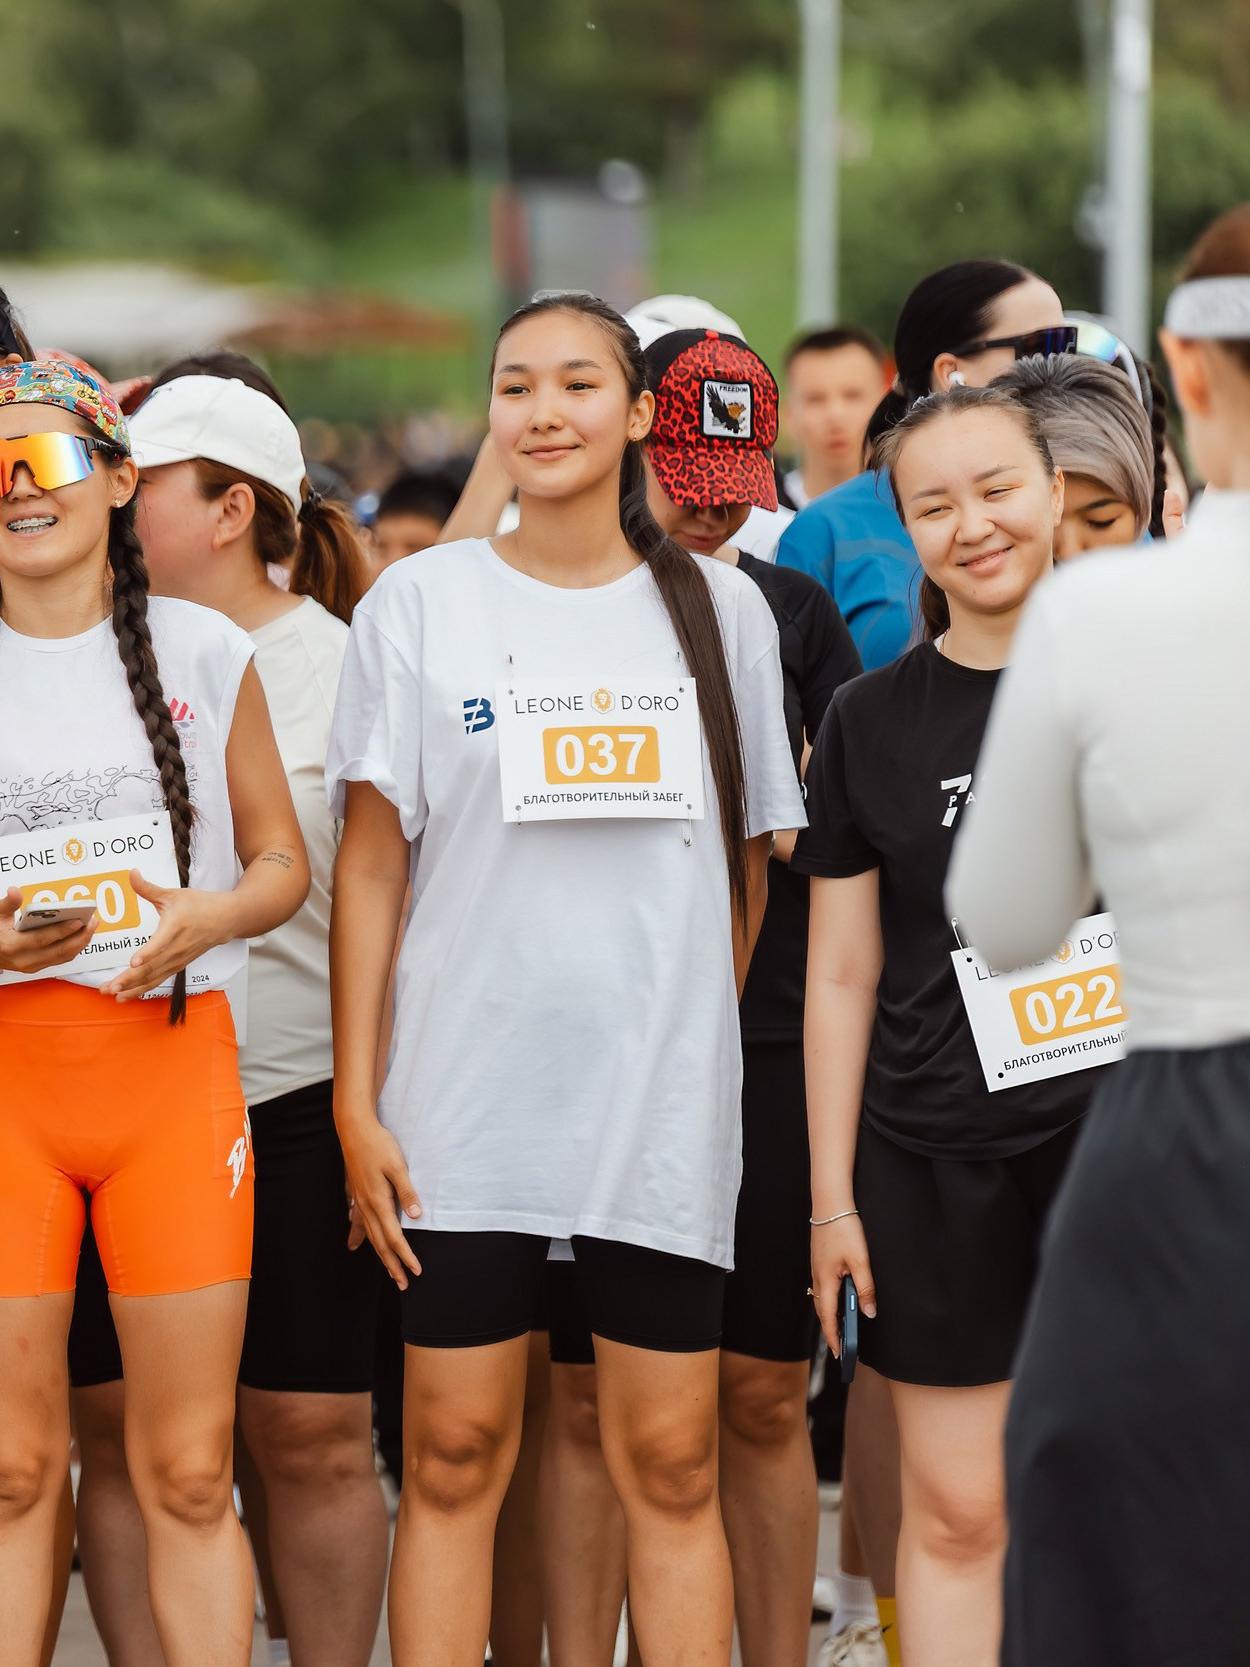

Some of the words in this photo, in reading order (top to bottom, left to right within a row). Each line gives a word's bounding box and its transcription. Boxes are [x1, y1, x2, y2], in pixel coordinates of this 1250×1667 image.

[515, 695, 584, 714] LEONE
[622, 695, 679, 711] D'ORO
[555, 733, 647, 777] 037
[523, 789, 650, 805] БЛАГОТВОРИТЕЛЬНЫЙ
[653, 792, 684, 803] ЗАБЕГ
[93, 834, 154, 857] D'ORO
[191, 975, 210, 983] 2024
[1025, 974, 1123, 1035] 022
